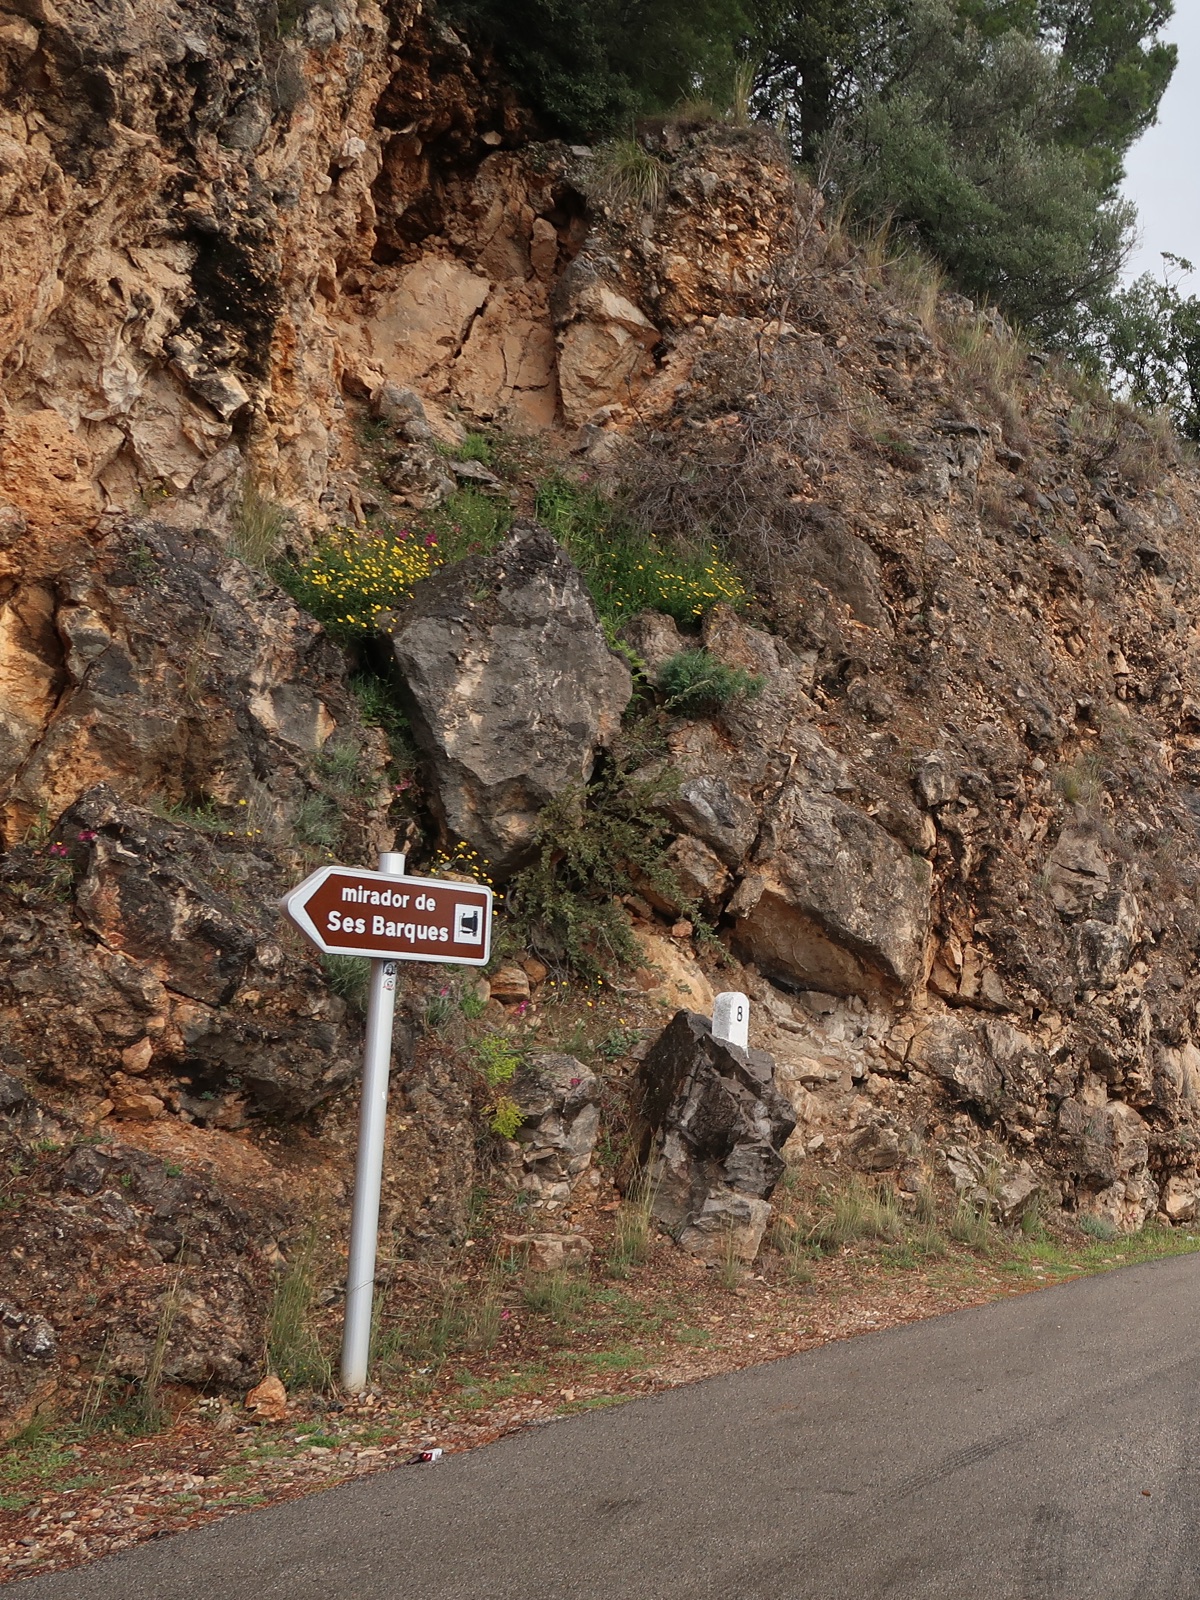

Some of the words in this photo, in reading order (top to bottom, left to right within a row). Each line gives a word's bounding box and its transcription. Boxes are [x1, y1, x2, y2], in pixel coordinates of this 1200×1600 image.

[341, 885, 410, 908] mirador
[414, 893, 437, 912] de
[326, 910, 367, 934] Ses
[372, 915, 449, 943] Barques
[737, 1005, 743, 1022] 8
